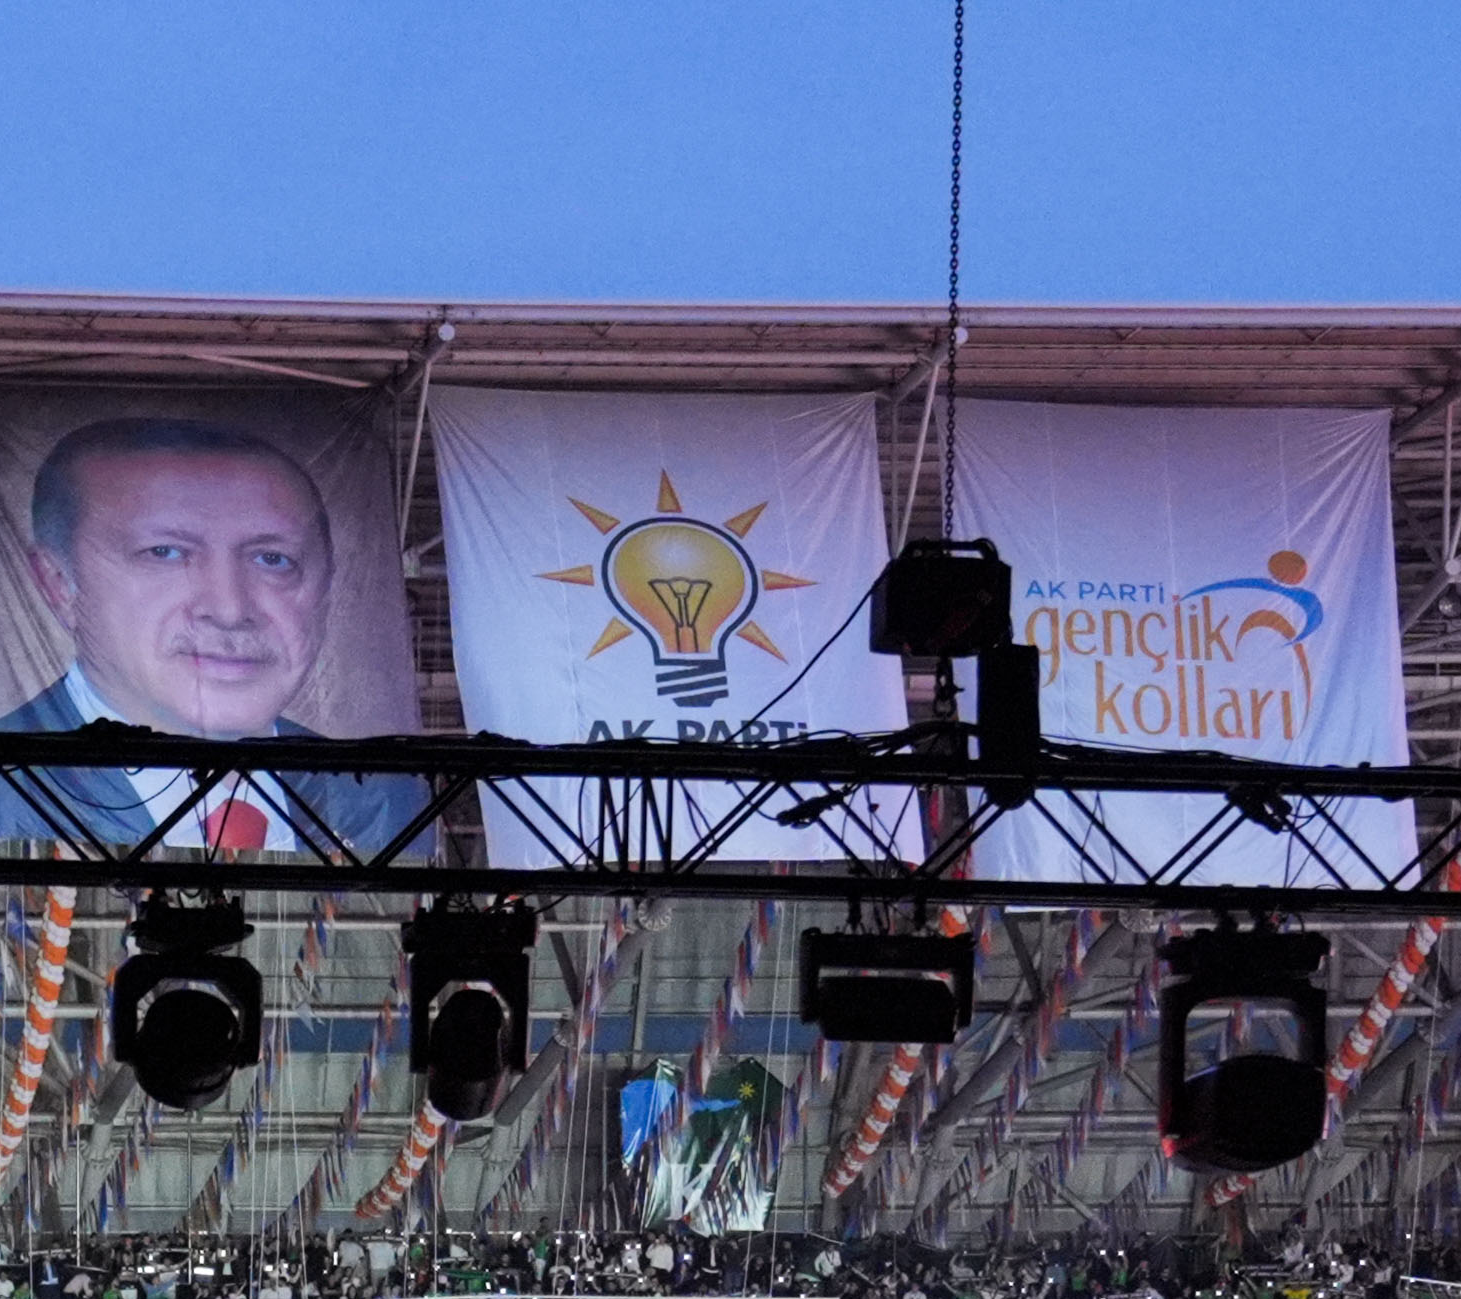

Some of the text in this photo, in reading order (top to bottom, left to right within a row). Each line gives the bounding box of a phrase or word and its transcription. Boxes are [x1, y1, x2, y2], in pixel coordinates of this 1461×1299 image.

[1026, 579, 1165, 604] AK PARTİ
[1026, 595, 1234, 688] gençlik
[1095, 660, 1293, 741] kolları
